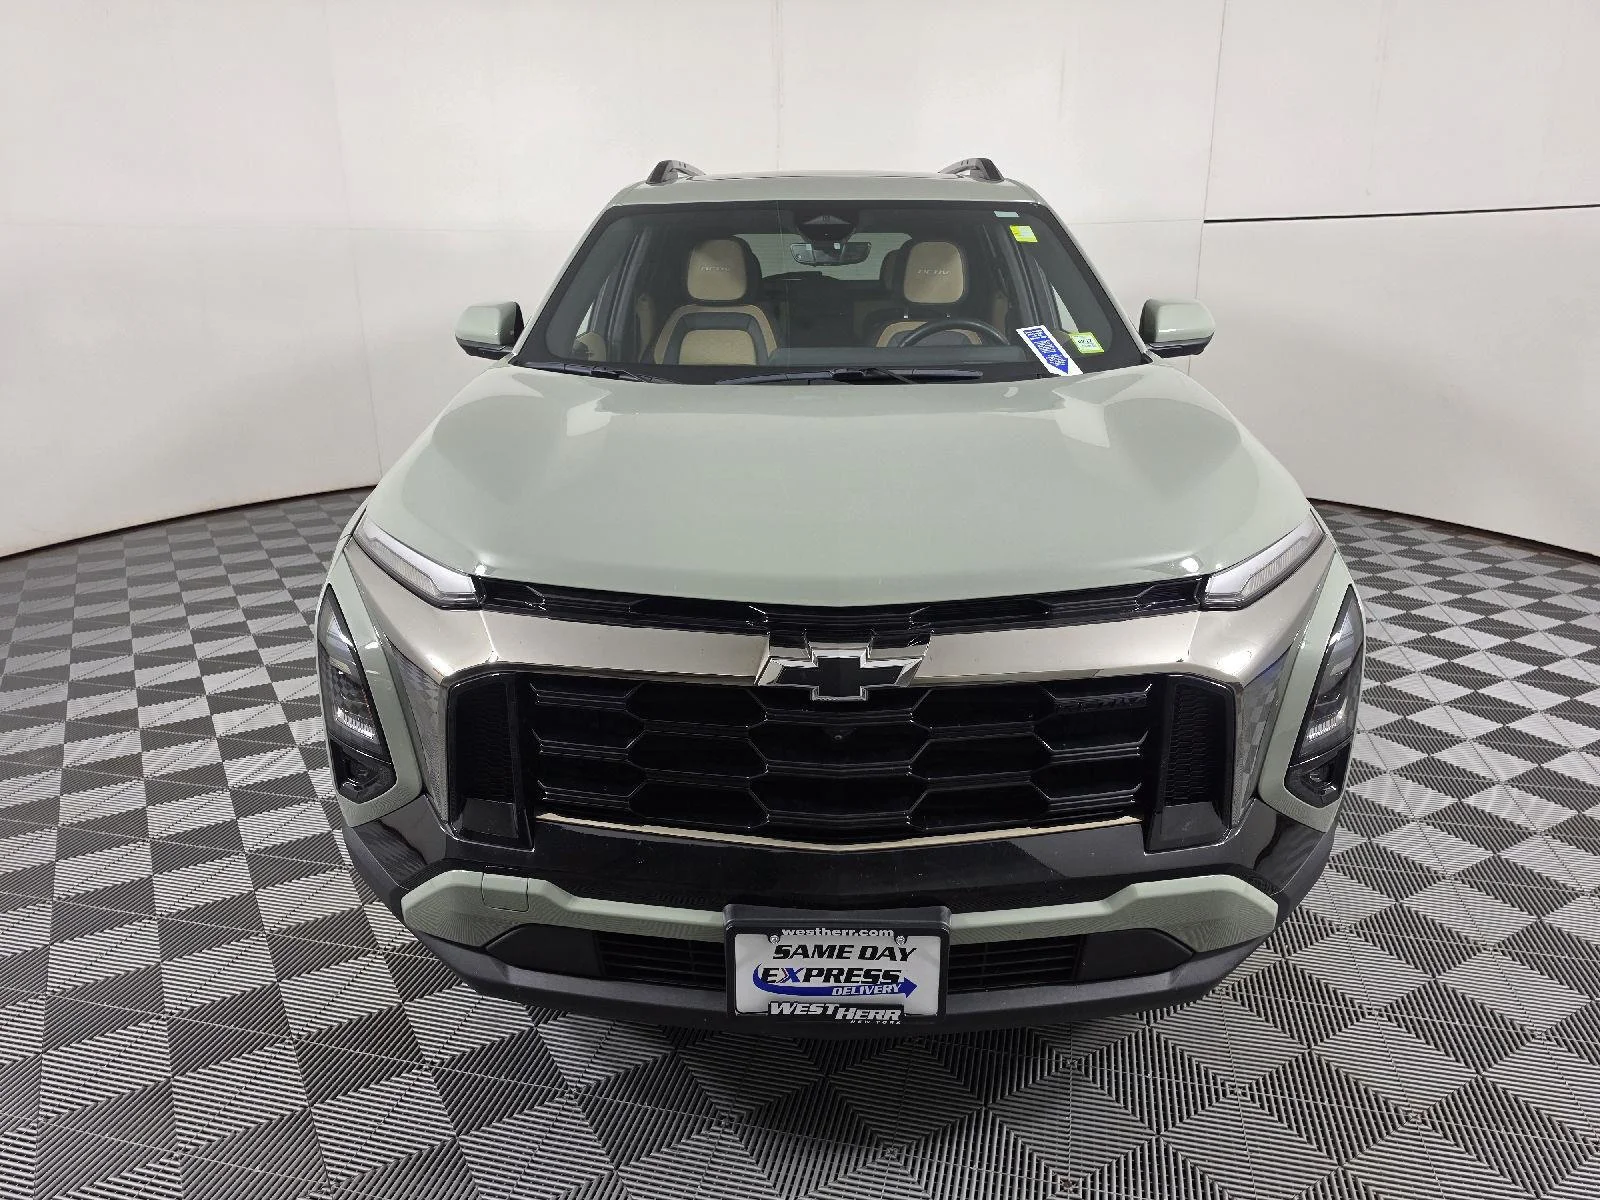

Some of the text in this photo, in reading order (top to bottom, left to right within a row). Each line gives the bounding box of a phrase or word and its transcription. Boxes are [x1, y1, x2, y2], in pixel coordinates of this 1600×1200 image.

[781, 927, 894, 938] westherr.com
[772, 944, 917, 962] SAME DAY
[760, 967, 902, 985] EXPRESS
[831, 983, 902, 997] DELIVERY
